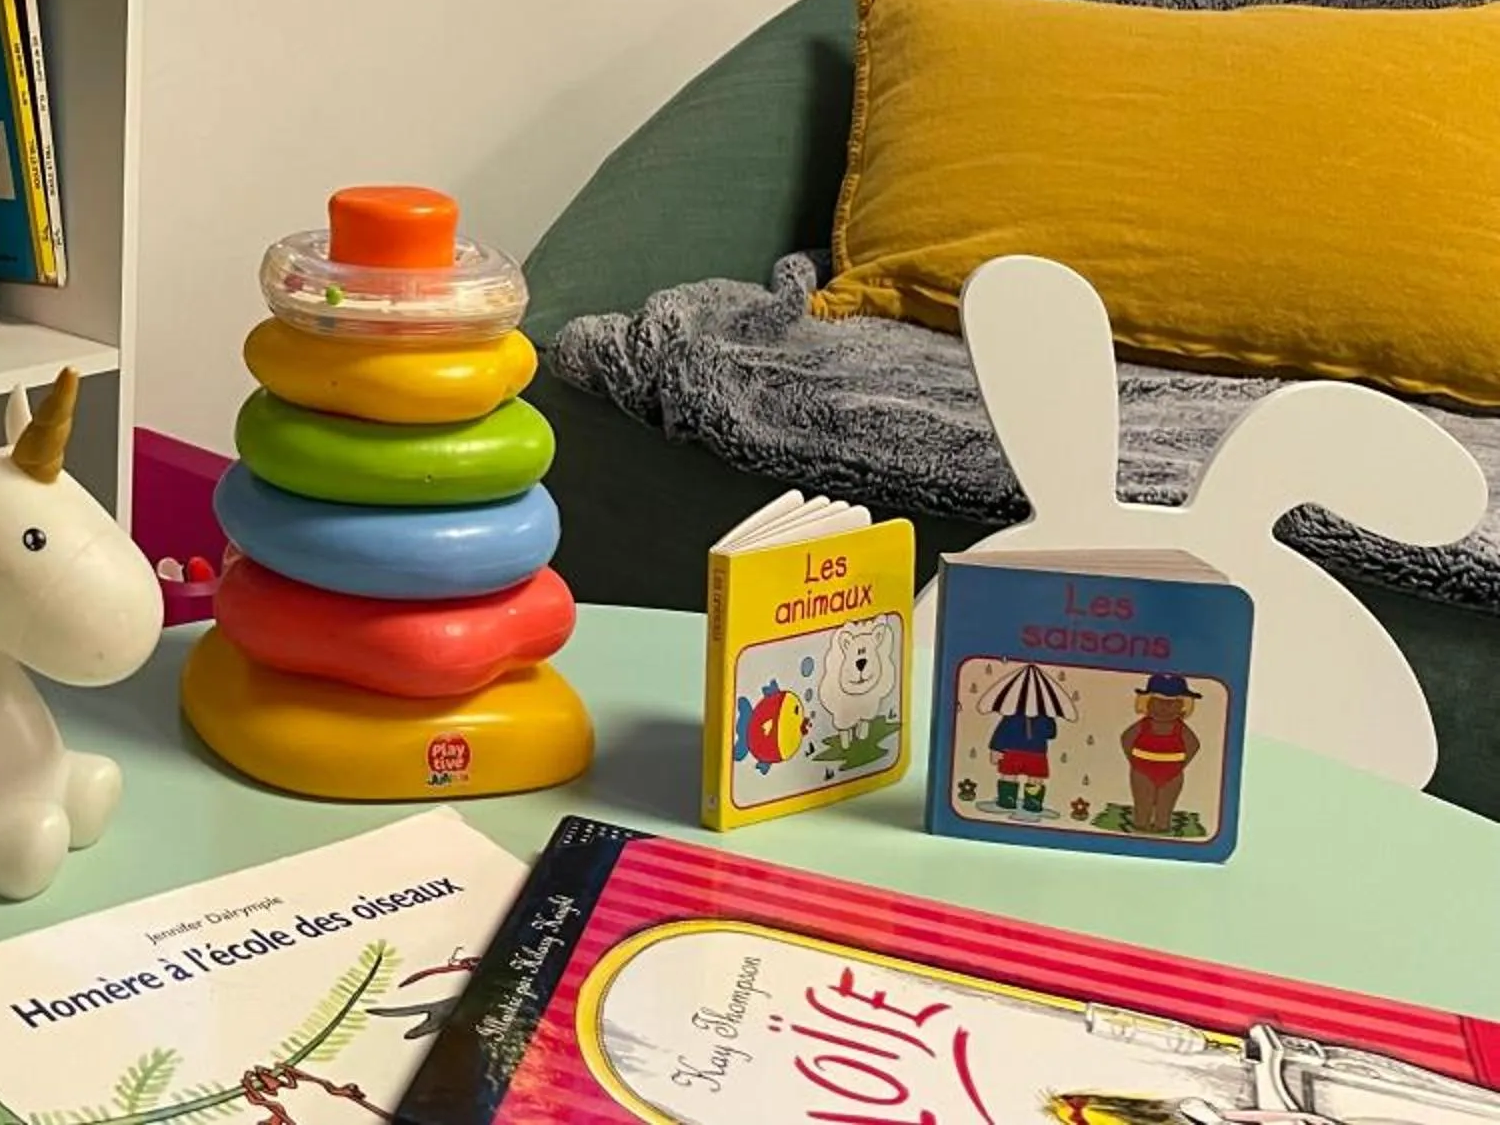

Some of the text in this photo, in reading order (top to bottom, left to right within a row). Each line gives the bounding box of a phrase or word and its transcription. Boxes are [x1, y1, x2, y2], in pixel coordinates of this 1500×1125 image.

[804, 552, 848, 584] Les
[775, 583, 873, 625] animaux
[1064, 582, 1135, 620] Les
[1020, 622, 1171, 660] saisons
[431, 743, 465, 757] Play
[433, 757, 464, 770] tive
[146, 895, 285, 945] Jennifer Dalrymple
[10, 876, 464, 1029] Homère à l'école des oiseaux
[516, 976, 539, 1000] par
[672, 956, 772, 1093] Kay Thompson
[768, 966, 952, 1125] LOÏSE
